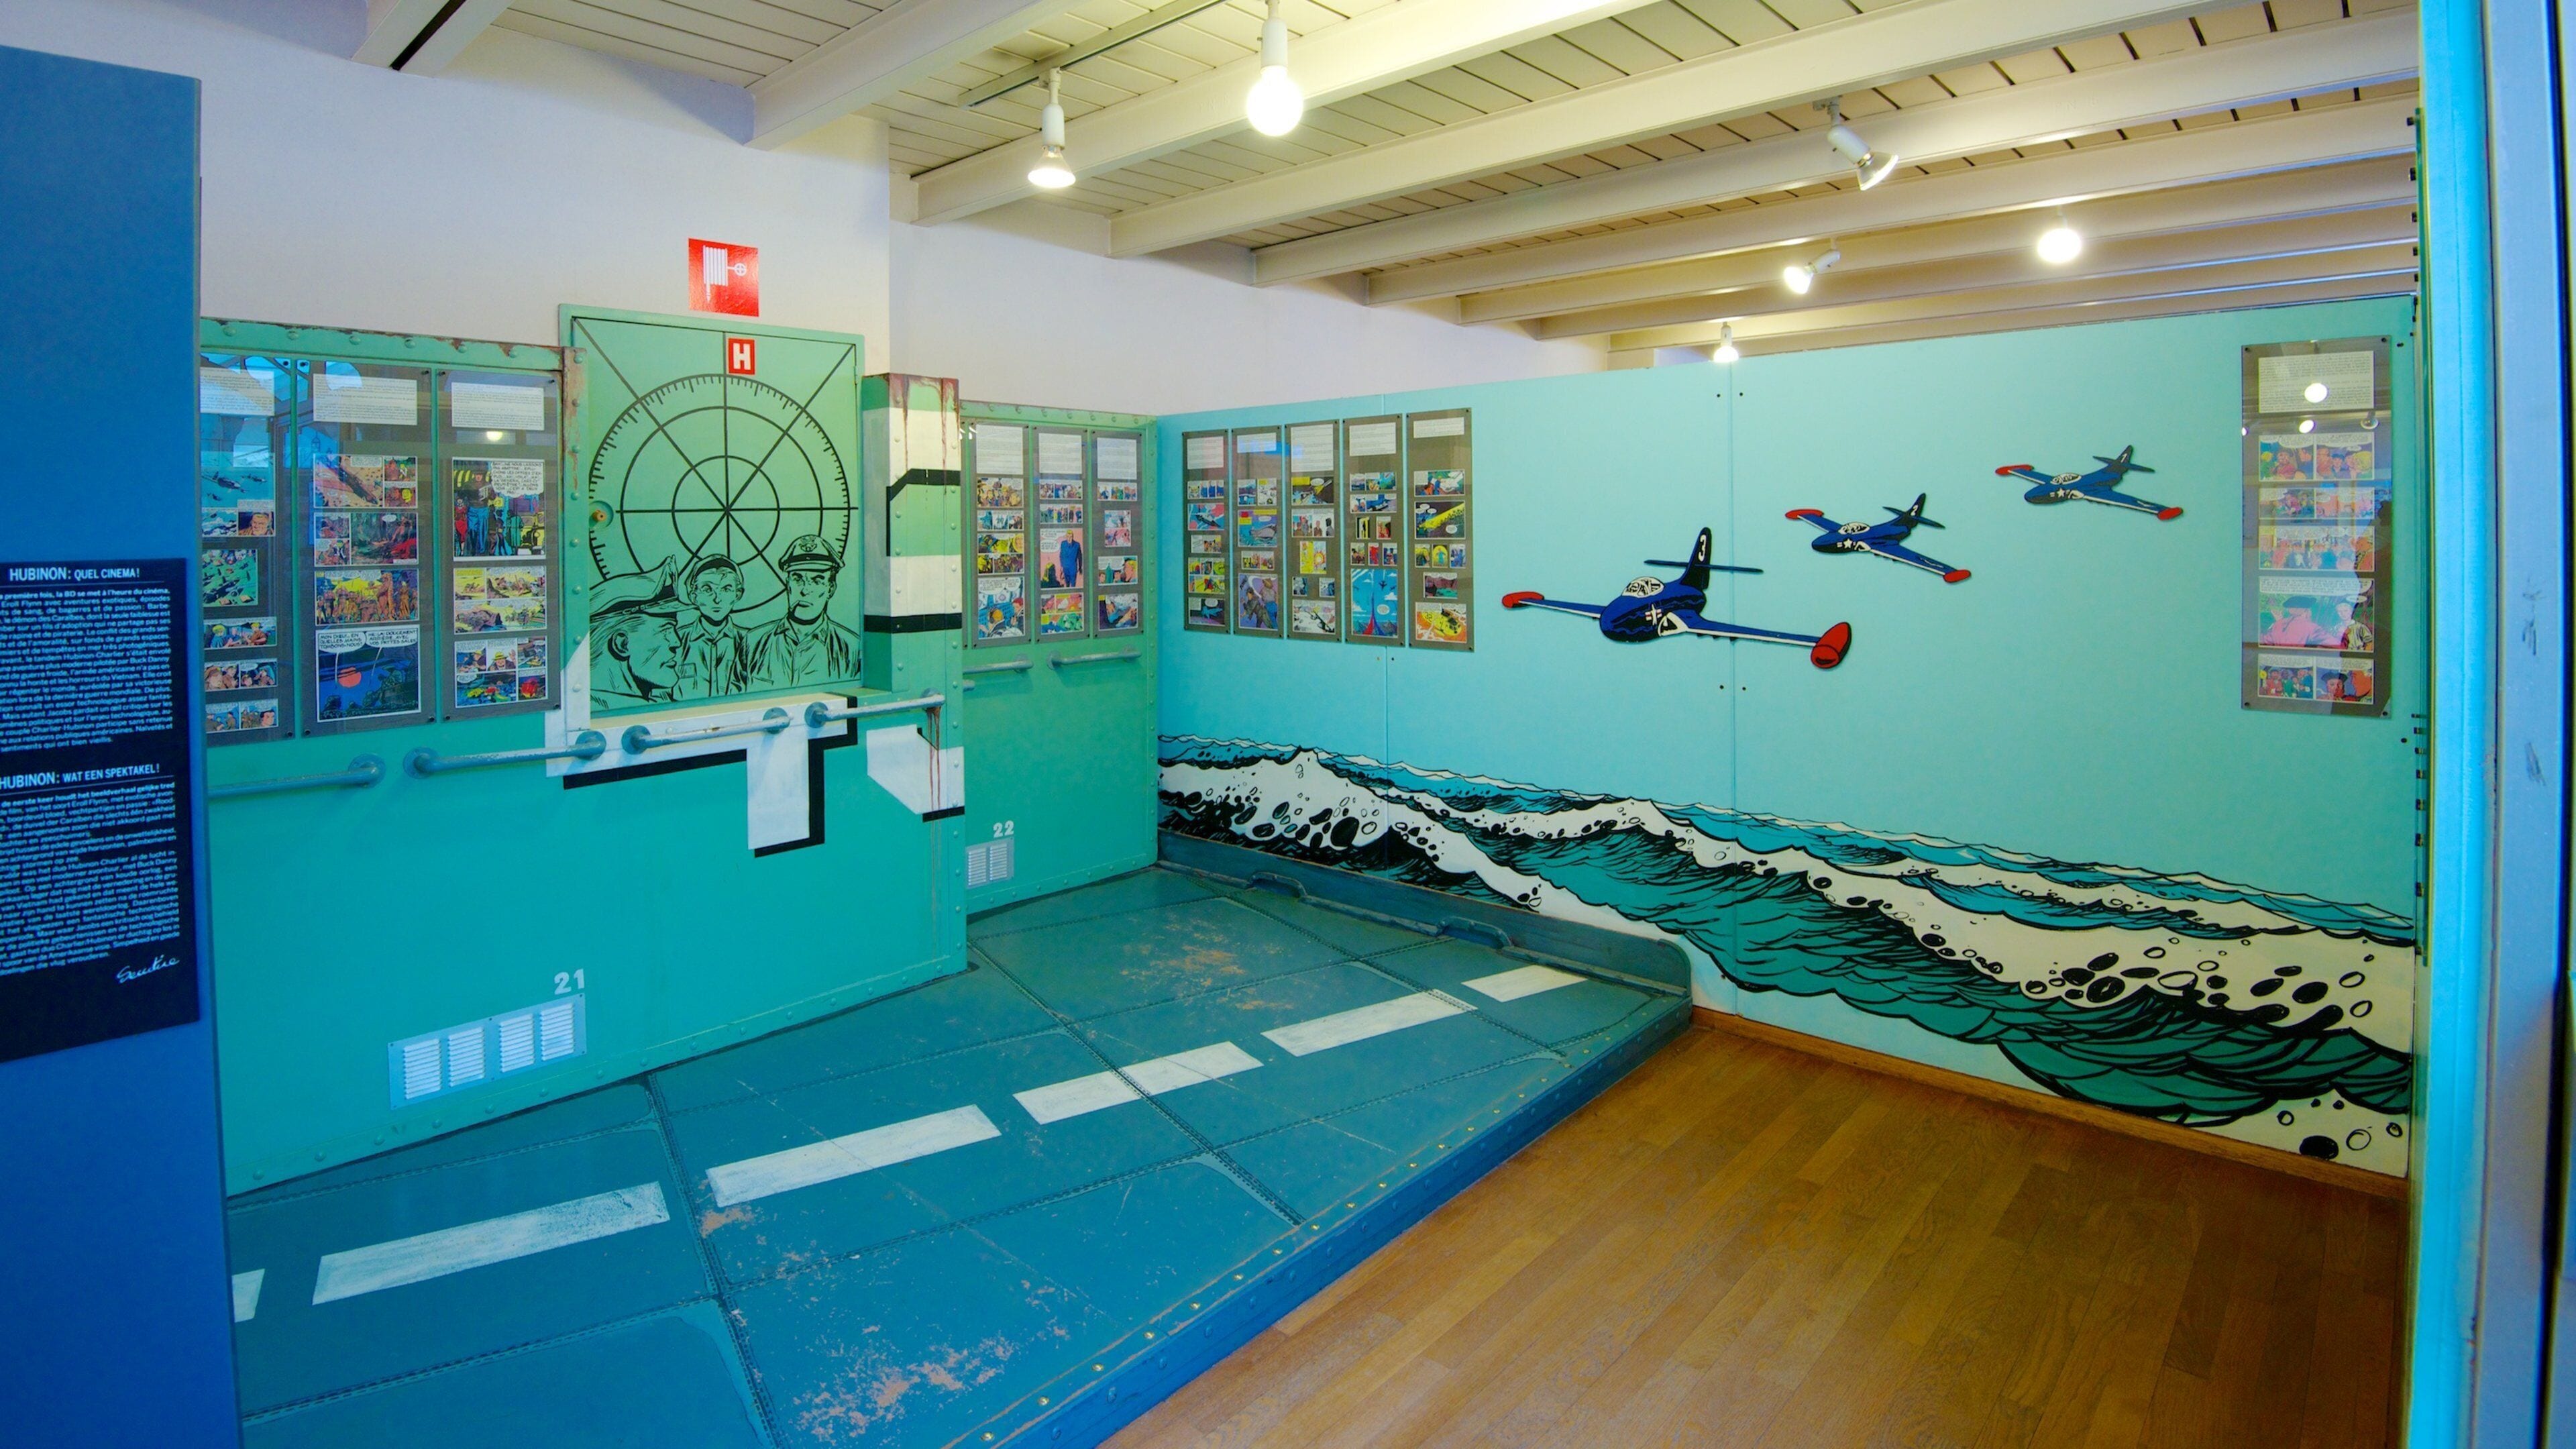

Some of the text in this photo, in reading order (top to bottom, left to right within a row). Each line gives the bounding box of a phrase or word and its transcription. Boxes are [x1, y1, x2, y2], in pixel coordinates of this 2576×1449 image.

[733, 343, 751, 370] H
[2121, 453, 2127, 463] 1
[1911, 504, 1919, 516] 2
[1699, 535, 1707, 561] 3
[9, 567, 72, 582] HUBINON:
[74, 569, 99, 580] QUEL
[0, 771, 60, 790] HUBINON:
[62, 771, 82, 784] WAT
[85, 769, 103, 781] EEN
[993, 820, 1014, 838] 22
[554, 969, 585, 995] 21
